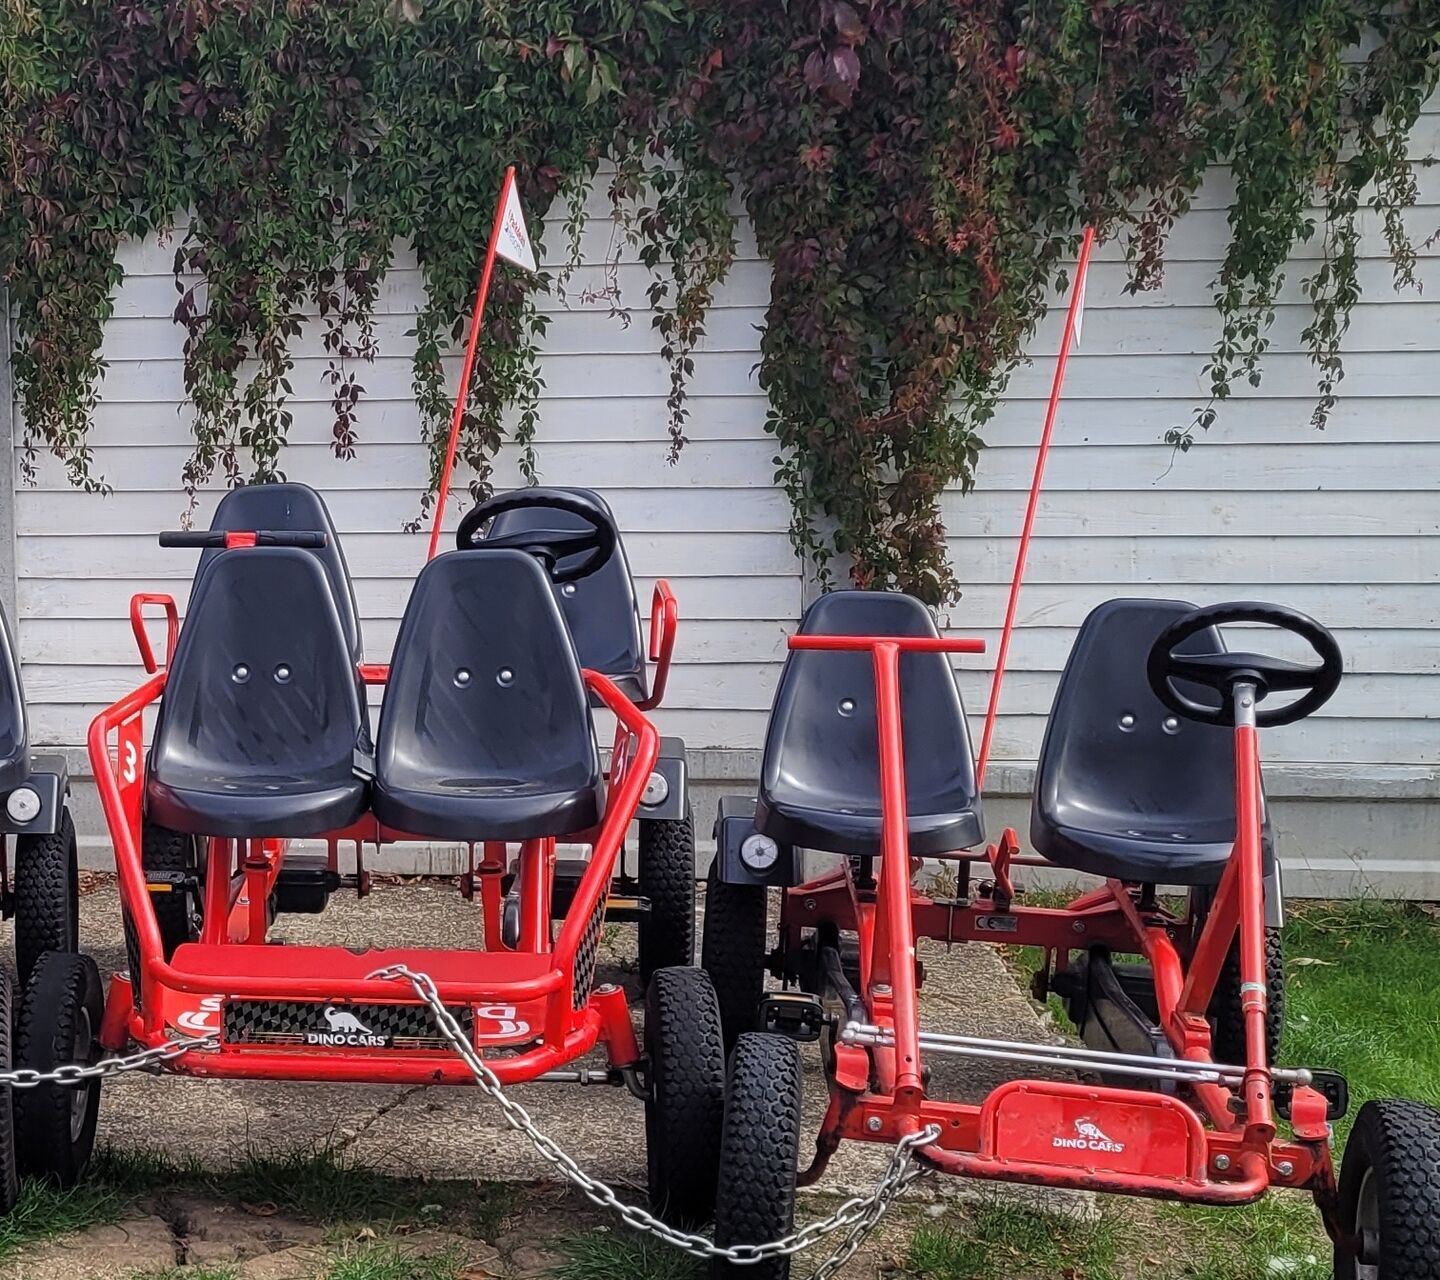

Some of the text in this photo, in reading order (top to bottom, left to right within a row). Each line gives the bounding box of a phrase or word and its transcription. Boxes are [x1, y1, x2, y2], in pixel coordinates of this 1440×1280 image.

[123, 740, 137, 784] 3
[976, 916, 996, 929] CE
[307, 1033, 346, 1045] DINO
[1052, 1137, 1124, 1153] DINO CARS
